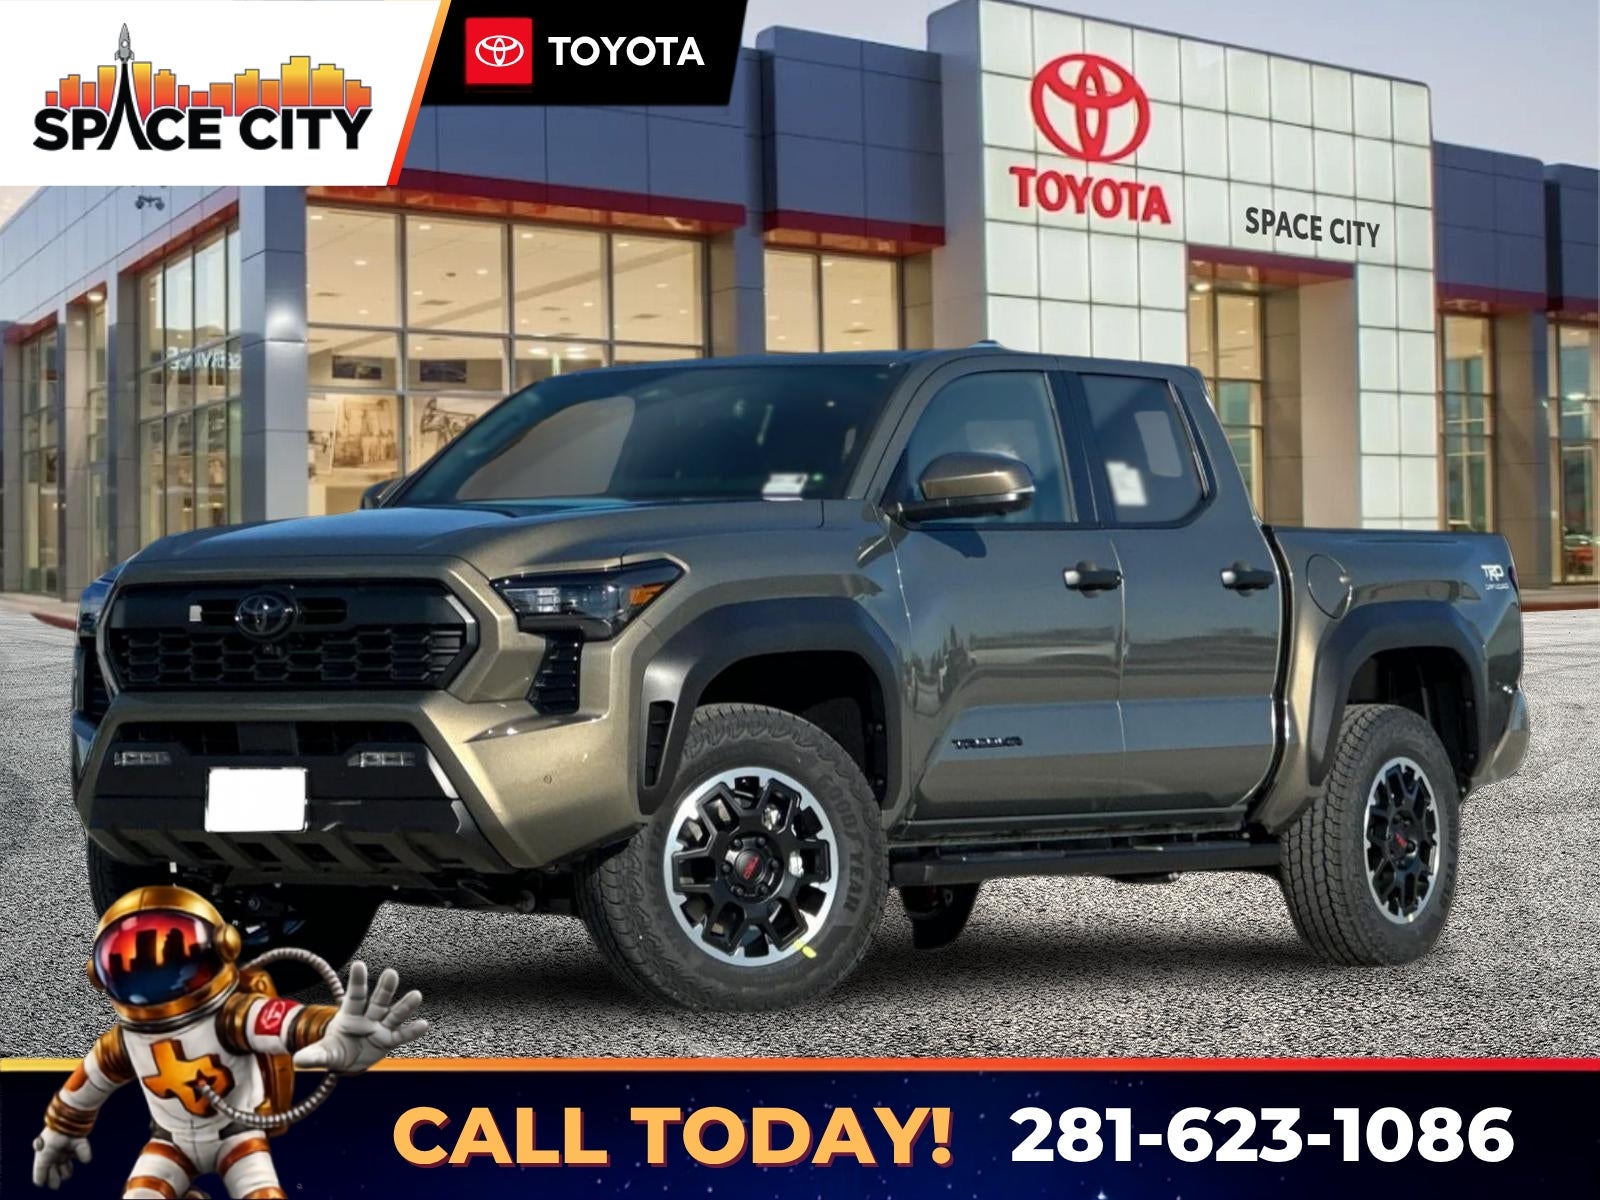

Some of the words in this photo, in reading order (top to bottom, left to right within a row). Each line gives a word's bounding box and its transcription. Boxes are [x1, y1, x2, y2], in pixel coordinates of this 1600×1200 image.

[1009, 166, 1172, 225] TOYOTA
[1245, 206, 1323, 242] SPACE
[1329, 217, 1381, 248] CITY
[1480, 564, 1504, 581] TRD
